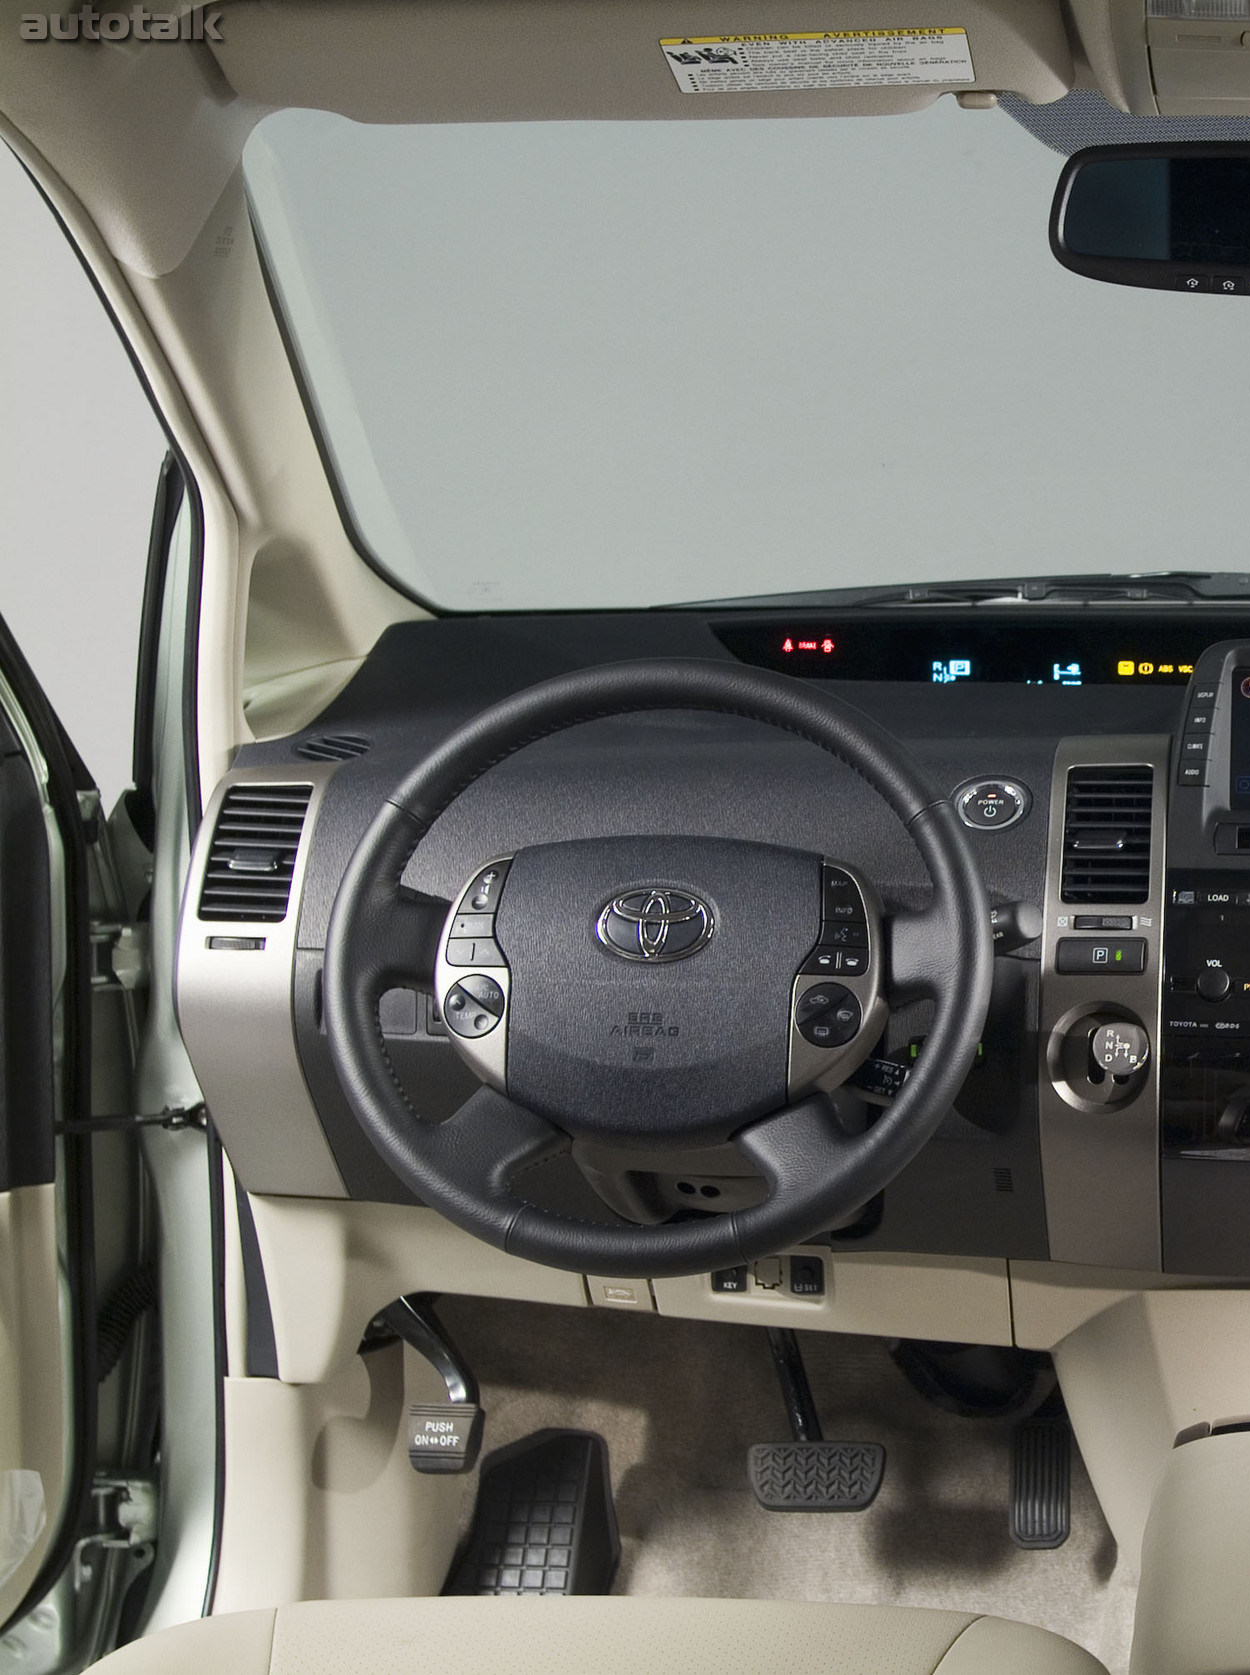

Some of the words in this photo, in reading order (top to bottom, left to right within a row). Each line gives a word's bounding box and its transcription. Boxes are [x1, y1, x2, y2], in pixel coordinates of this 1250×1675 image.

[719, 34, 789, 42] WARNING
[823, 29, 945, 38] AVERTISSEMENT
[932, 661, 943, 671] R
[1158, 664, 1174, 673] ABS
[1178, 664, 1193, 674] VSC
[932, 672, 943, 683] N
[1207, 893, 1229, 902] LOAD
[835, 907, 853, 915] INFO
[1205, 959, 1223, 968] VOL
[479, 990, 500, 999] AUTO
[628, 1012, 664, 1023] SRS
[609, 1024, 680, 1037] AIRBAG
[1106, 1029, 1115, 1038] R
[1105, 1041, 1114, 1050] N
[1104, 1053, 1113, 1063] D
[1129, 1055, 1138, 1064] B
[425, 1421, 454, 1433] PUSH
[414, 1434, 429, 1446] ON
[439, 1434, 461, 1447] OFF
